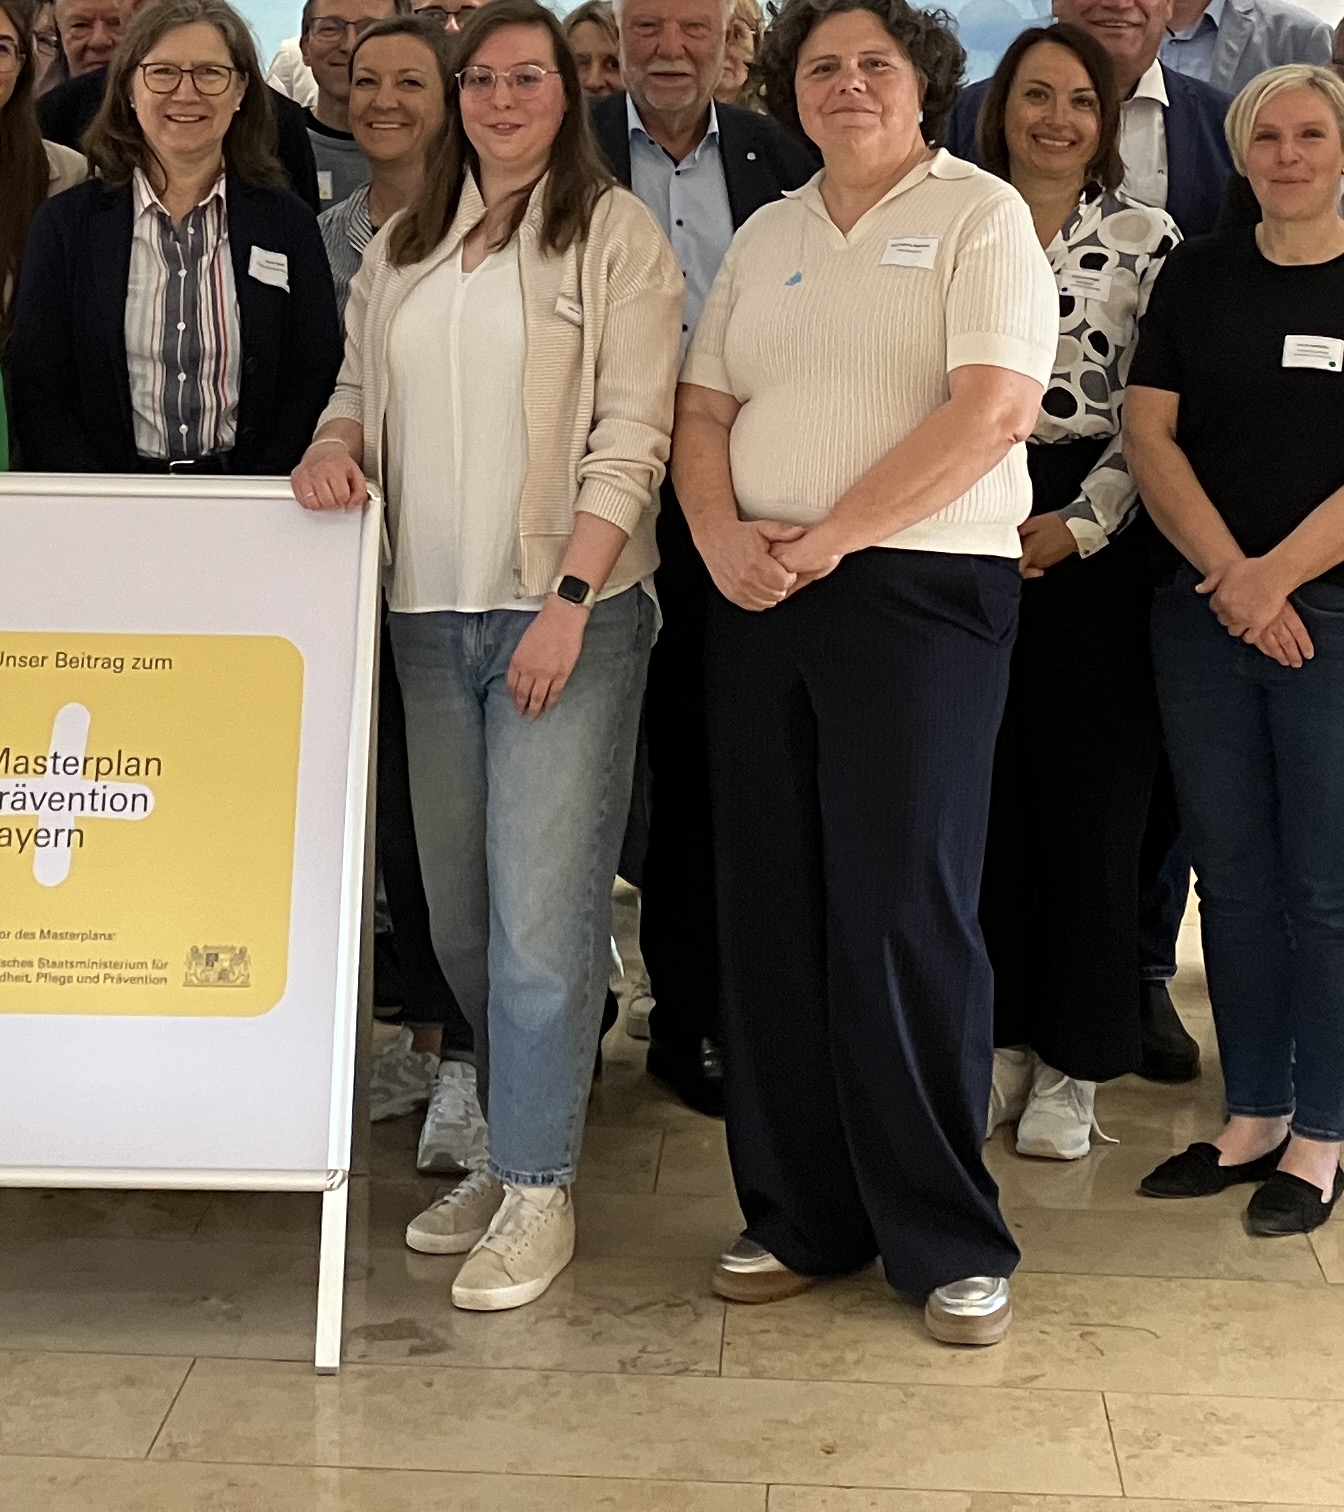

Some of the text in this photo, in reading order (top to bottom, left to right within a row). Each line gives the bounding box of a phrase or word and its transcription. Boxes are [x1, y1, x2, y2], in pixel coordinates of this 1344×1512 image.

[55, 651, 125, 674] Beitrag
[131, 656, 173, 671] zum
[14, 929, 36, 940] des
[37, 957, 149, 971] Staatsministerium
[151, 959, 169, 970] für
[35, 972, 74, 986] Pflege
[76, 974, 100, 984] und
[102, 973, 168, 986] Prävention
